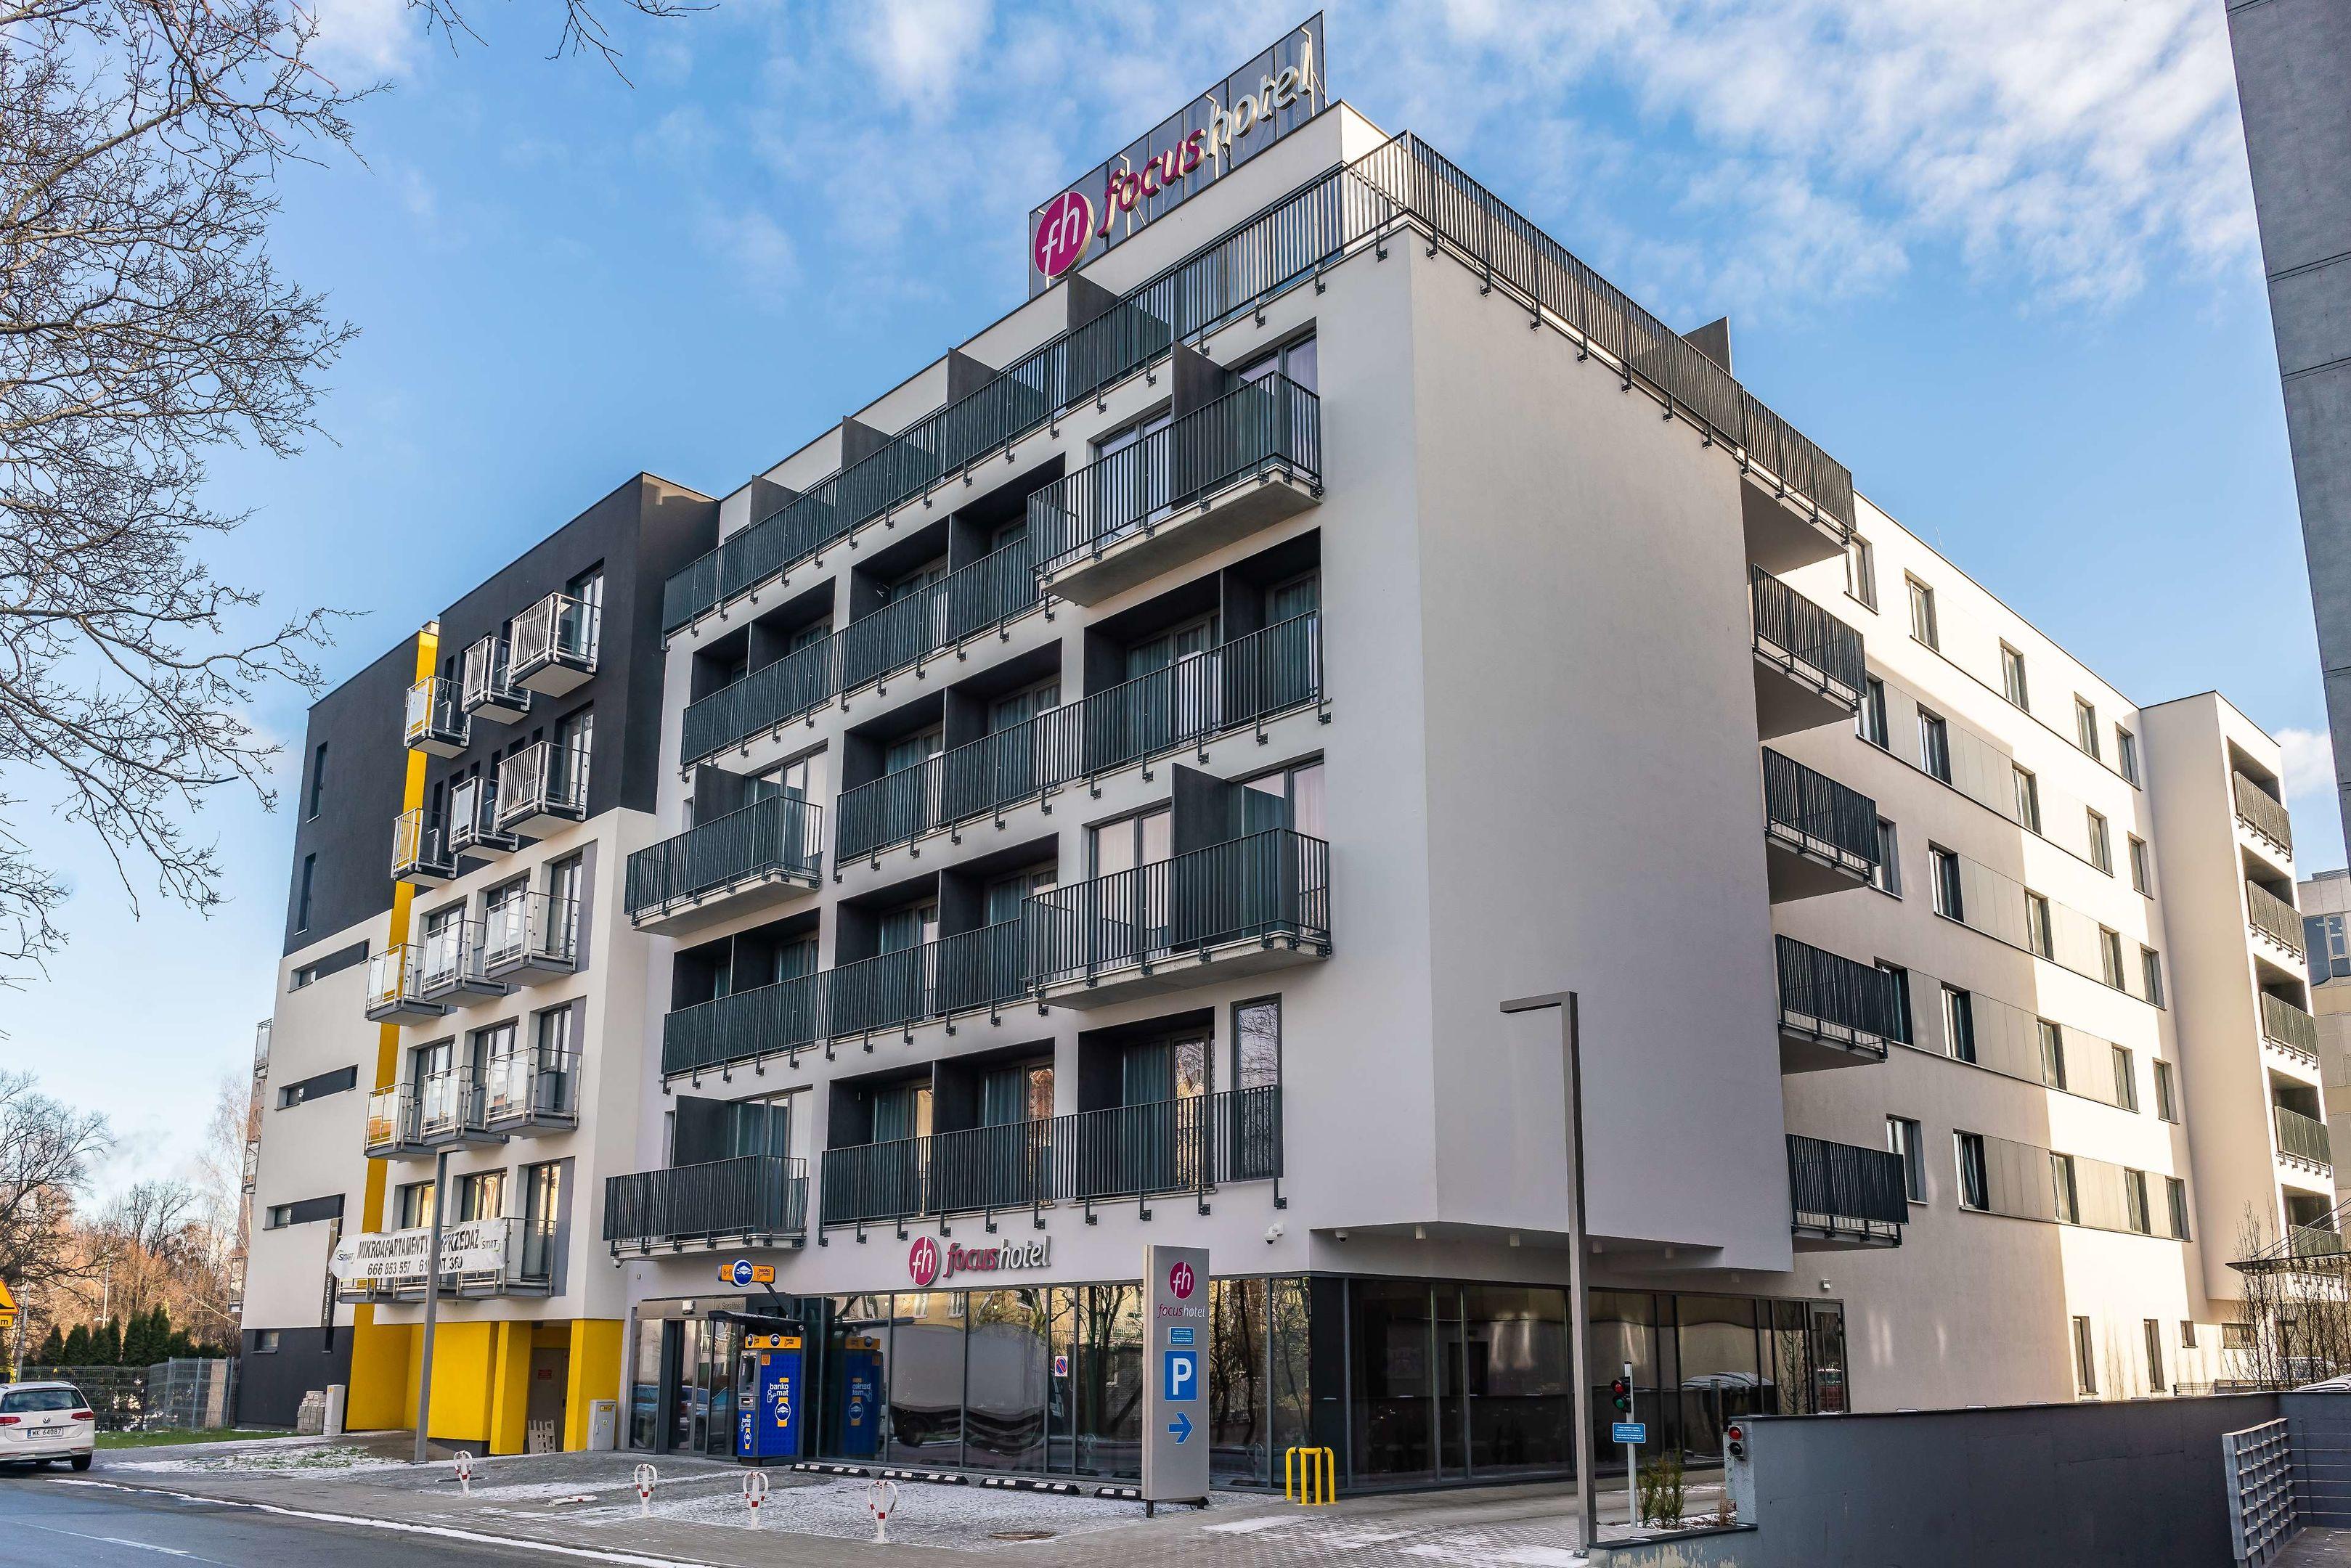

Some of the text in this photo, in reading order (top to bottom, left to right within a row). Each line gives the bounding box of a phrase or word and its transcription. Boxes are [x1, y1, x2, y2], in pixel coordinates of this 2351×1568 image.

[1096, 40, 1312, 240] focushotel
[1041, 192, 1080, 277] fh
[367, 1262, 383, 1275] 666
[384, 1262, 397, 1275] 853
[419, 1259, 430, 1272] 61
[912, 1236, 933, 1282] fh
[942, 1235, 1052, 1279] focushotel
[1173, 1262, 1191, 1297] fh
[1157, 1304, 1206, 1319] focushotel
[1173, 1357, 1192, 1395] P
